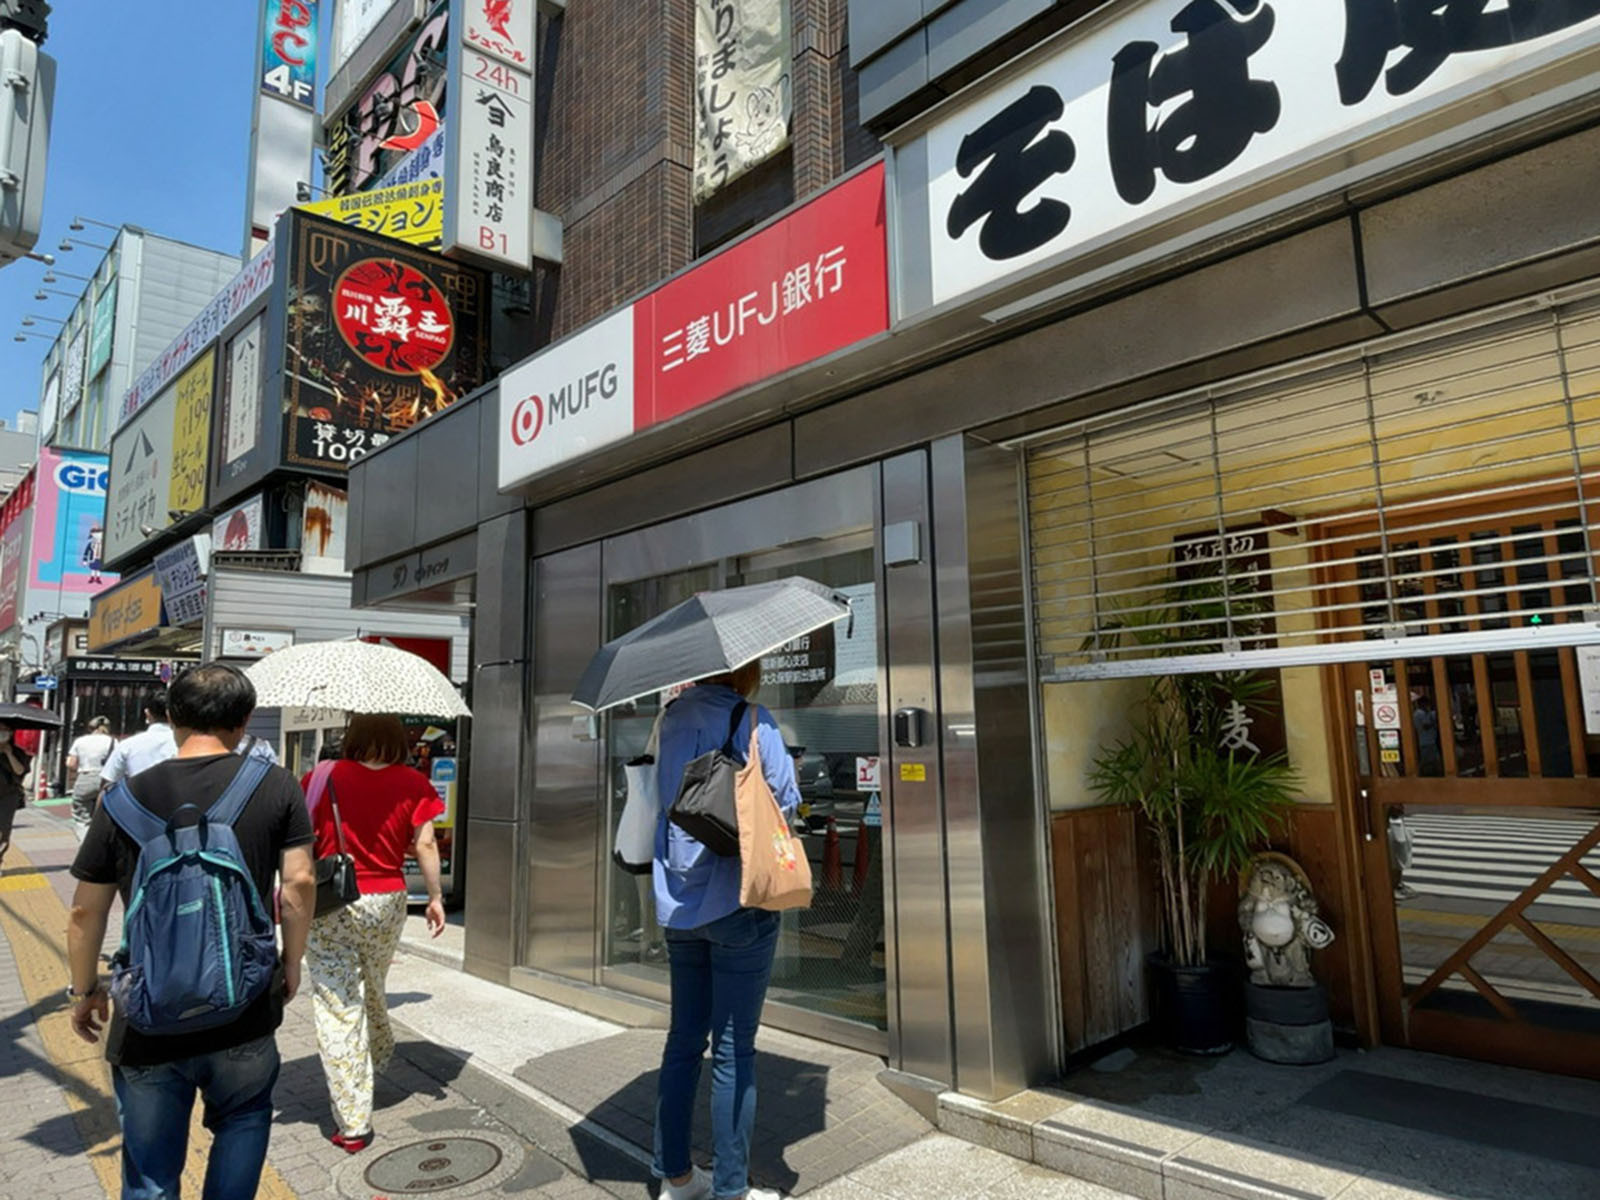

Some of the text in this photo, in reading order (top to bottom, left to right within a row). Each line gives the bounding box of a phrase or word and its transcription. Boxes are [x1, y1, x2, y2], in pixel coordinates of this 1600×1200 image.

[264, 64, 312, 100] 4F
[475, 57, 518, 94] 24h
[710, 0, 737, 192] りましょう
[480, 226, 507, 254] B1
[662, 246, 847, 371] 三菱UFJ銀行
[548, 363, 618, 424] MUFG
